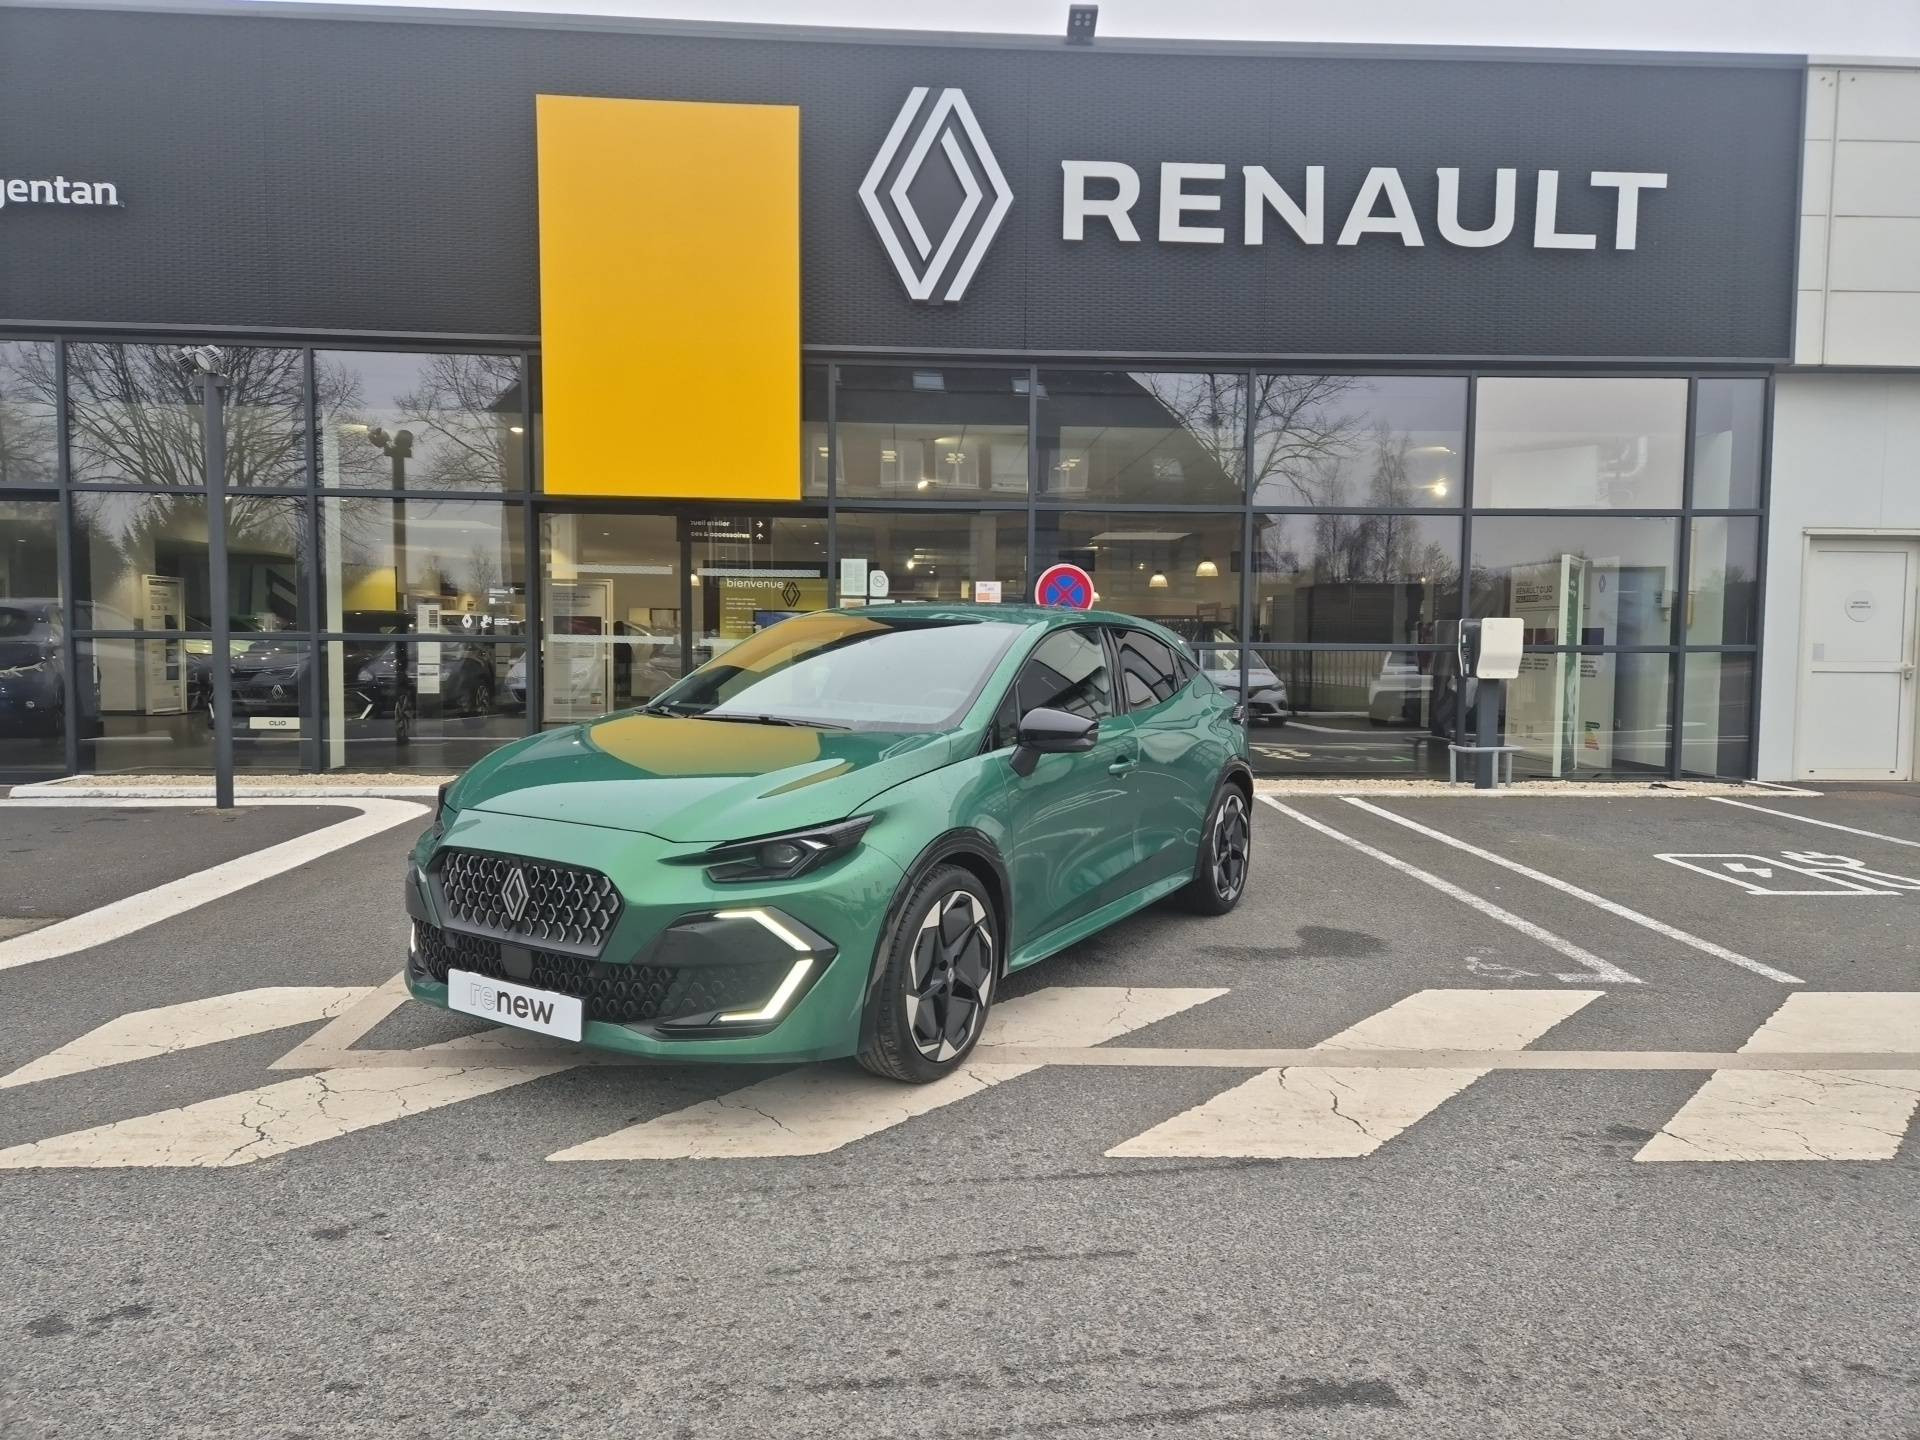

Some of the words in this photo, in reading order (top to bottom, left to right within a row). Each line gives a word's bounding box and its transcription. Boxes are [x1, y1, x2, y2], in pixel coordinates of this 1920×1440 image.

[0, 175, 119, 209] entan
[1061, 159, 1668, 250] RENAULT
[726, 578, 785, 589] bienvenue
[470, 982, 554, 1024] renew
